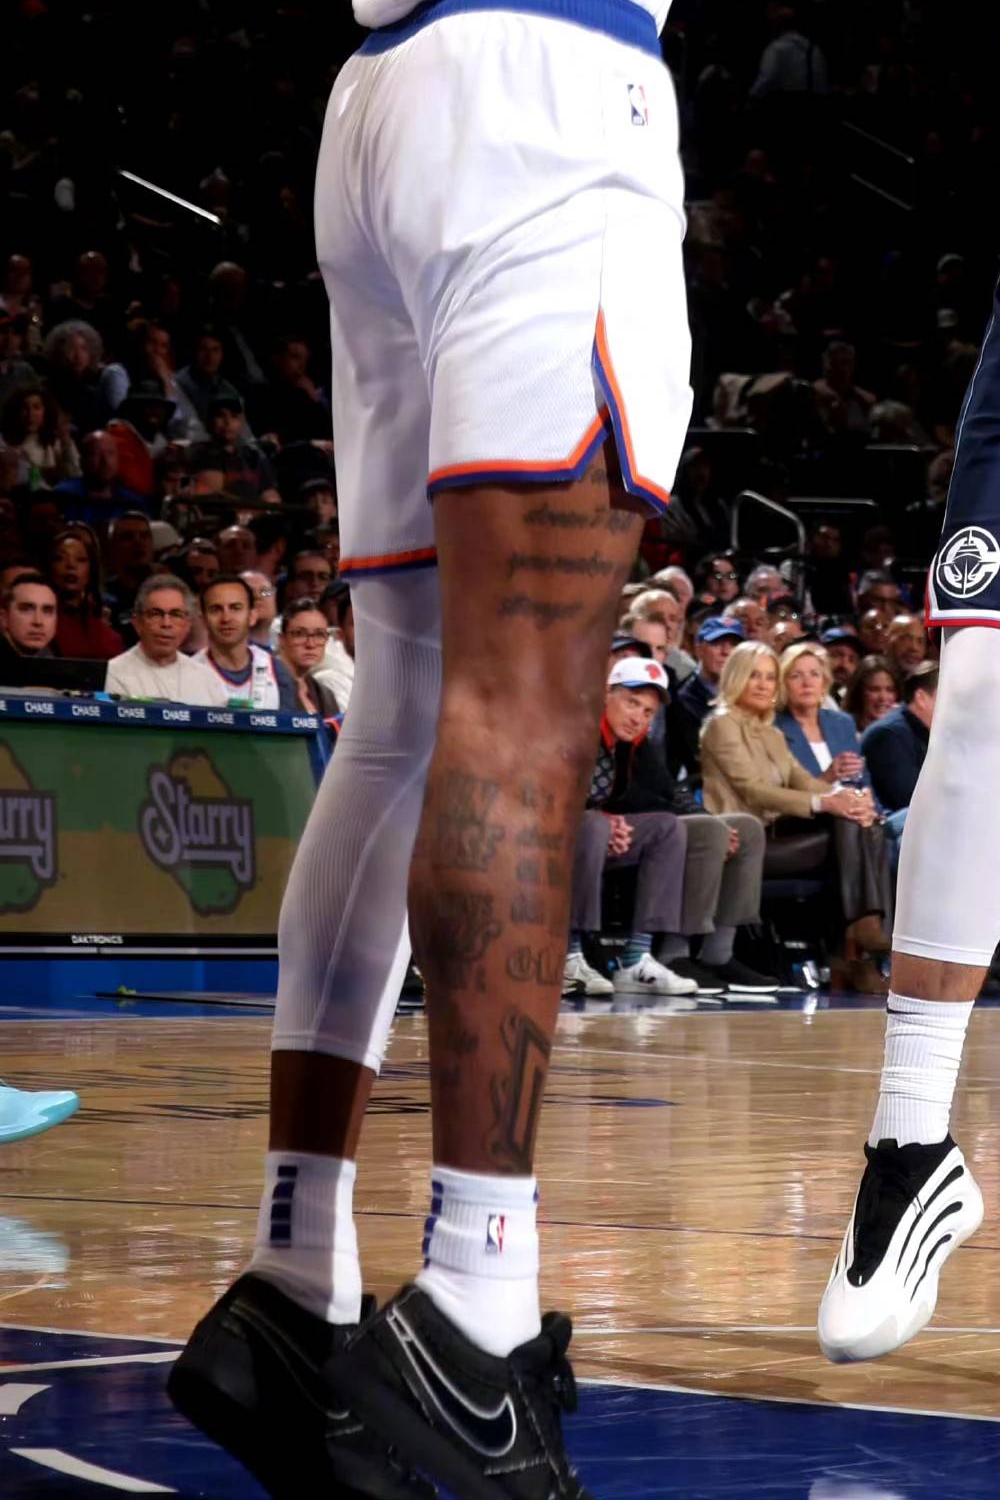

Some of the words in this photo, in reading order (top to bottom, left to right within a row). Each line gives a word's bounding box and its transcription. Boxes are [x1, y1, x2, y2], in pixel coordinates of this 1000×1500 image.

[24, 701, 55, 715] CHASE
[71, 704, 101, 718] CHASE
[117, 706, 146, 719] CHASE
[162, 709, 191, 722] CHASE
[206, 711, 235, 725] CHASE
[250, 715, 278, 727] CHASE
[291, 717, 319, 729] CHASE
[142, 771, 252, 882] Starry
